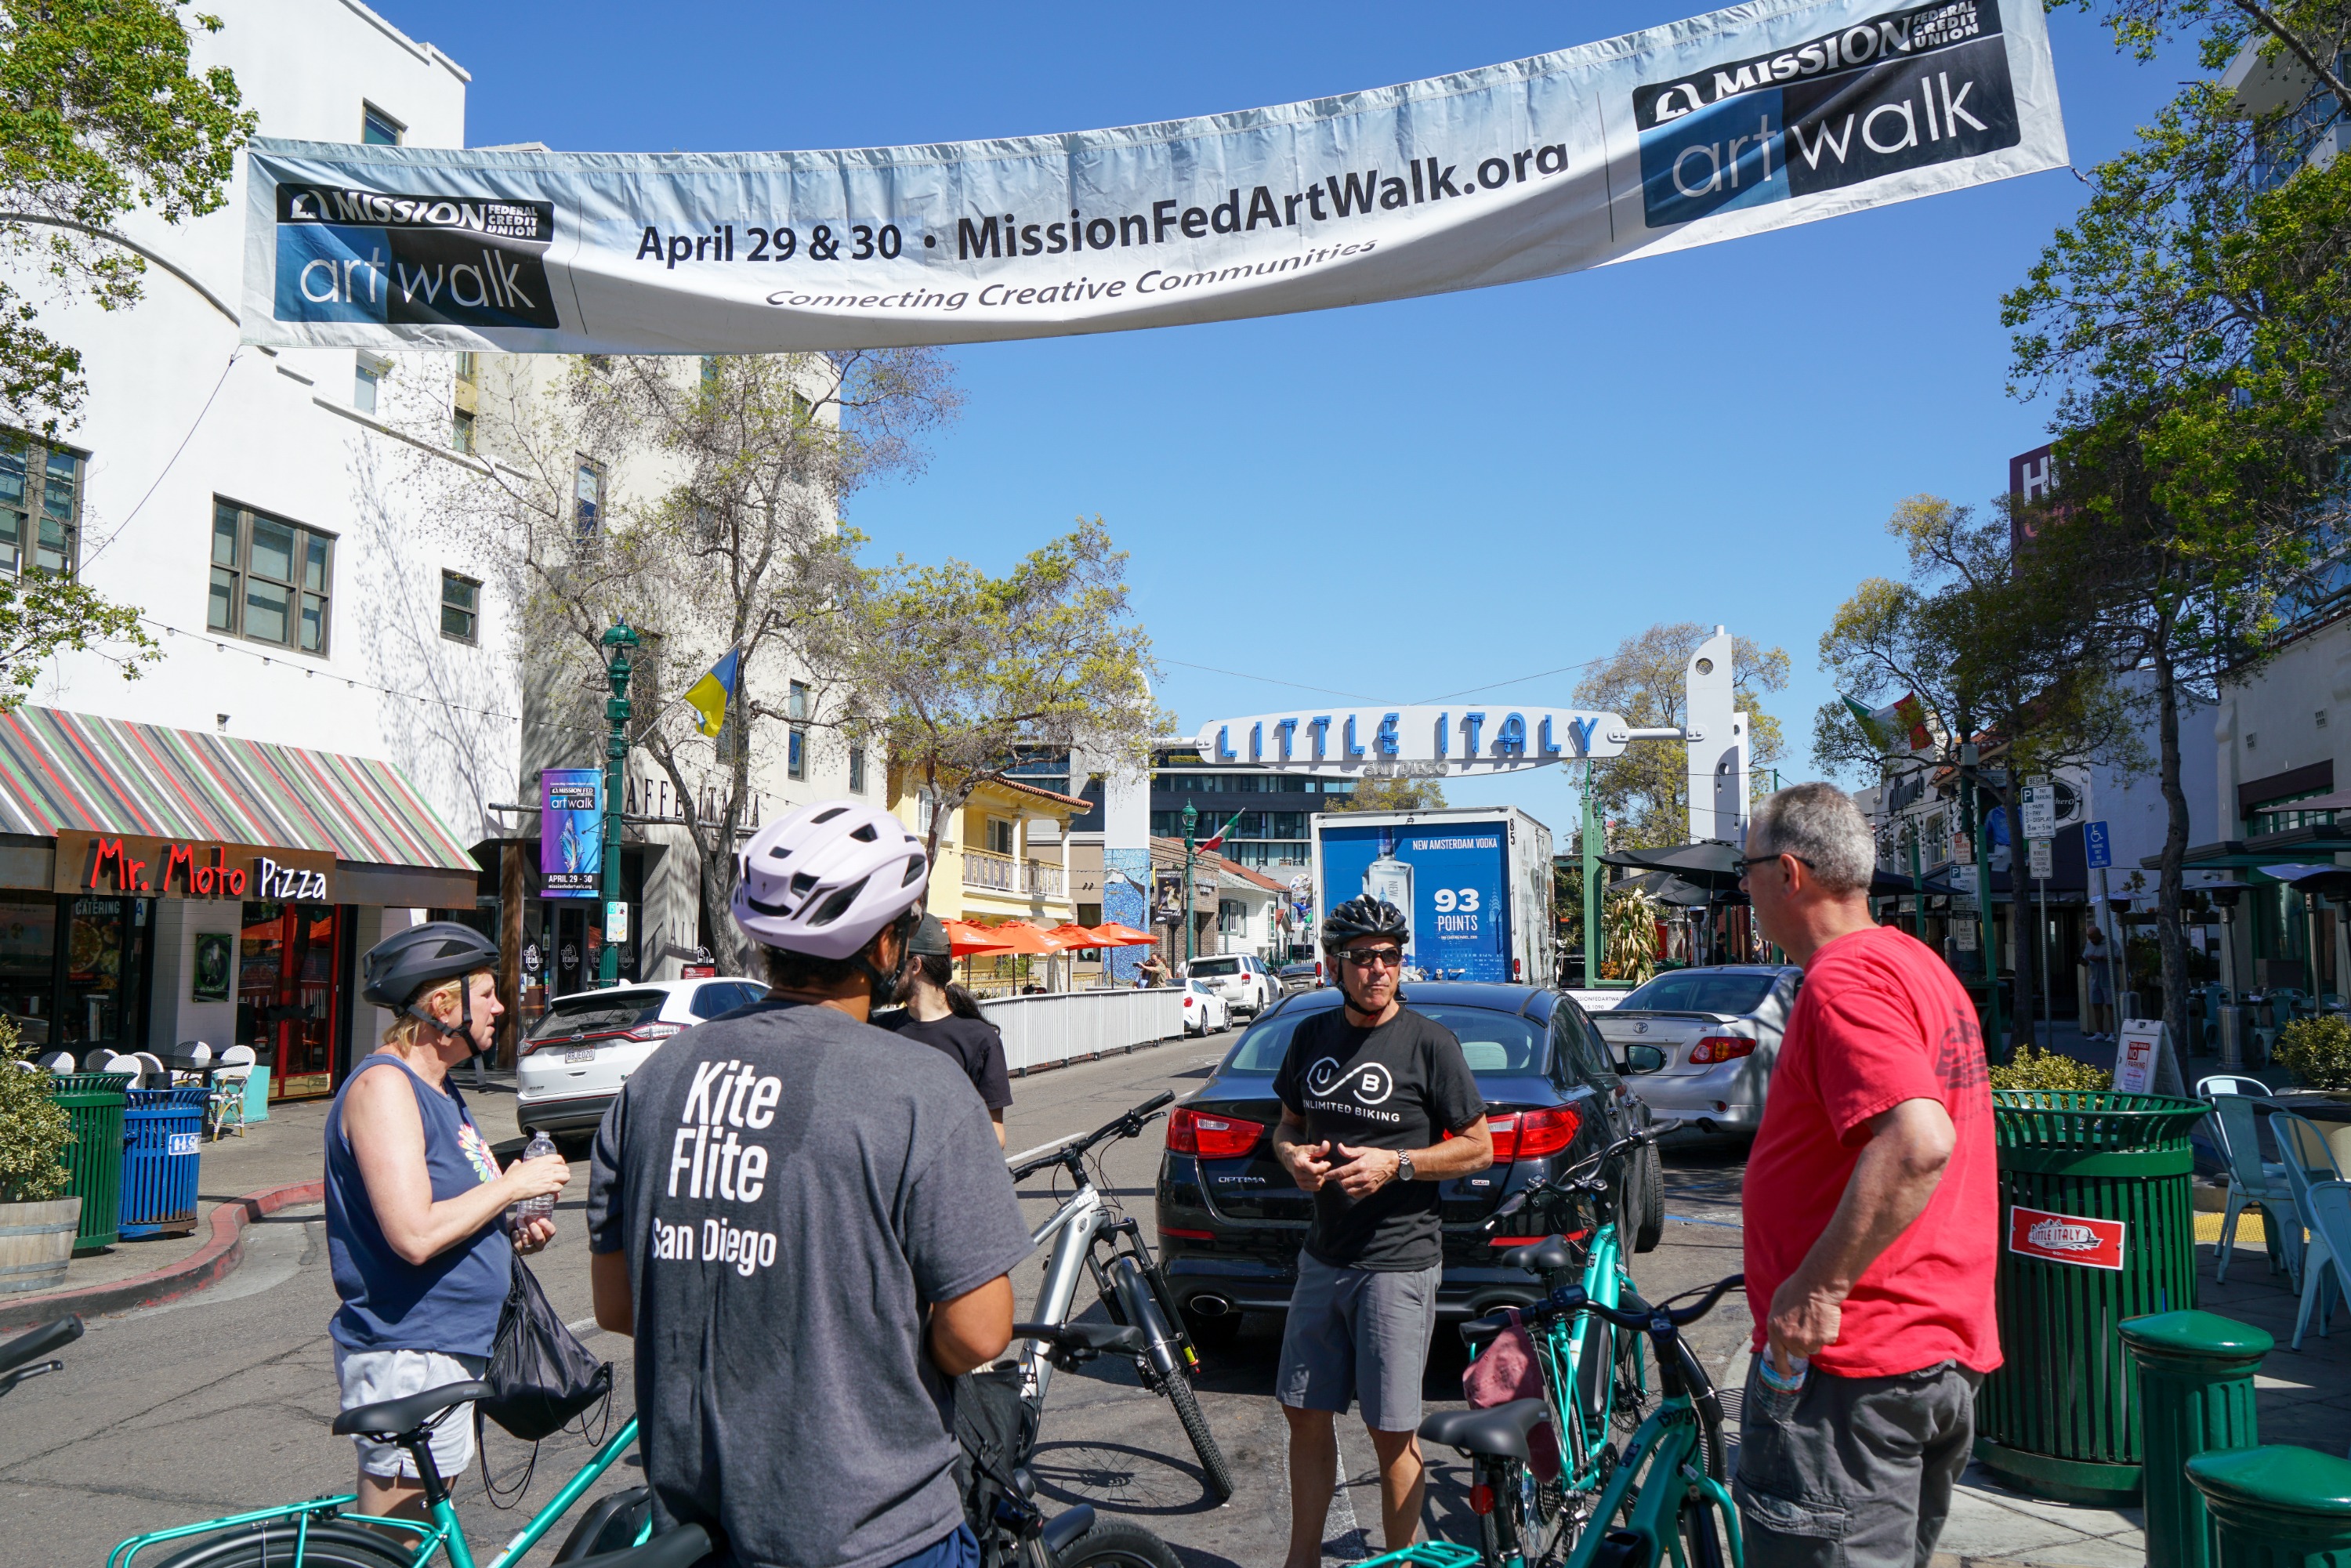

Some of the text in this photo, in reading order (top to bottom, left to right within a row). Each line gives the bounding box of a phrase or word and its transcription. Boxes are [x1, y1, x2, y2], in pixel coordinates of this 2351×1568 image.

[1913, 2, 1977, 25] FEDERAL
[1914, 13, 1978, 37] CREDIT
[1914, 23, 1980, 48] UNION
[1713, 16, 1912, 101] MISSION
[1791, 71, 1989, 171] walk
[339, 190, 487, 231] MISSION
[487, 204, 538, 216] FEDERAL
[487, 215, 538, 226] CREDIT
[486, 225, 538, 237] UNION
[636, 225, 734, 270] April
[747, 226, 797, 262] 29
[808, 224, 840, 261] &
[851, 223, 902, 260] 30
[397, 249, 535, 308] walk
[766, 239, 1378, 311] Connecting Creative Communities
[1219, 712, 1600, 759] LITTLE ITALY
[1366, 759, 1450, 776] SAN DIEGO
[2028, 776, 2046, 785] BEGIN
[567, 797, 593, 809] walk
[626, 777, 683, 819] AFFE
[2023, 790, 2032, 801] P
[1412, 838, 1498, 851] NEW AMSTERDAM VODKA
[90, 838, 326, 900] Mr. Moto Pizza
[548, 875, 568, 883] APRIL
[569, 875, 578, 883] 29
[583, 875, 593, 883] 30
[75, 900, 120, 915] CATERING
[136, 903, 143, 915] A
[1434, 888, 1480, 913] 93
[1437, 914, 1478, 932] POINTS
[525, 955, 543, 964] italia
[563, 954, 579, 963] italia
[2128, 1049, 2138, 1059] NO
[2128, 1060, 2146, 1069] PARKING
[1317, 1068, 1380, 1092] U B
[682, 1059, 782, 1129] Kite
[1354, 1106, 1400, 1122] BIKING
[668, 1124, 768, 1203] Flite
[2032, 1228, 2081, 1241] LITTLE ITALY
[652, 1217, 777, 1276] San Diego
